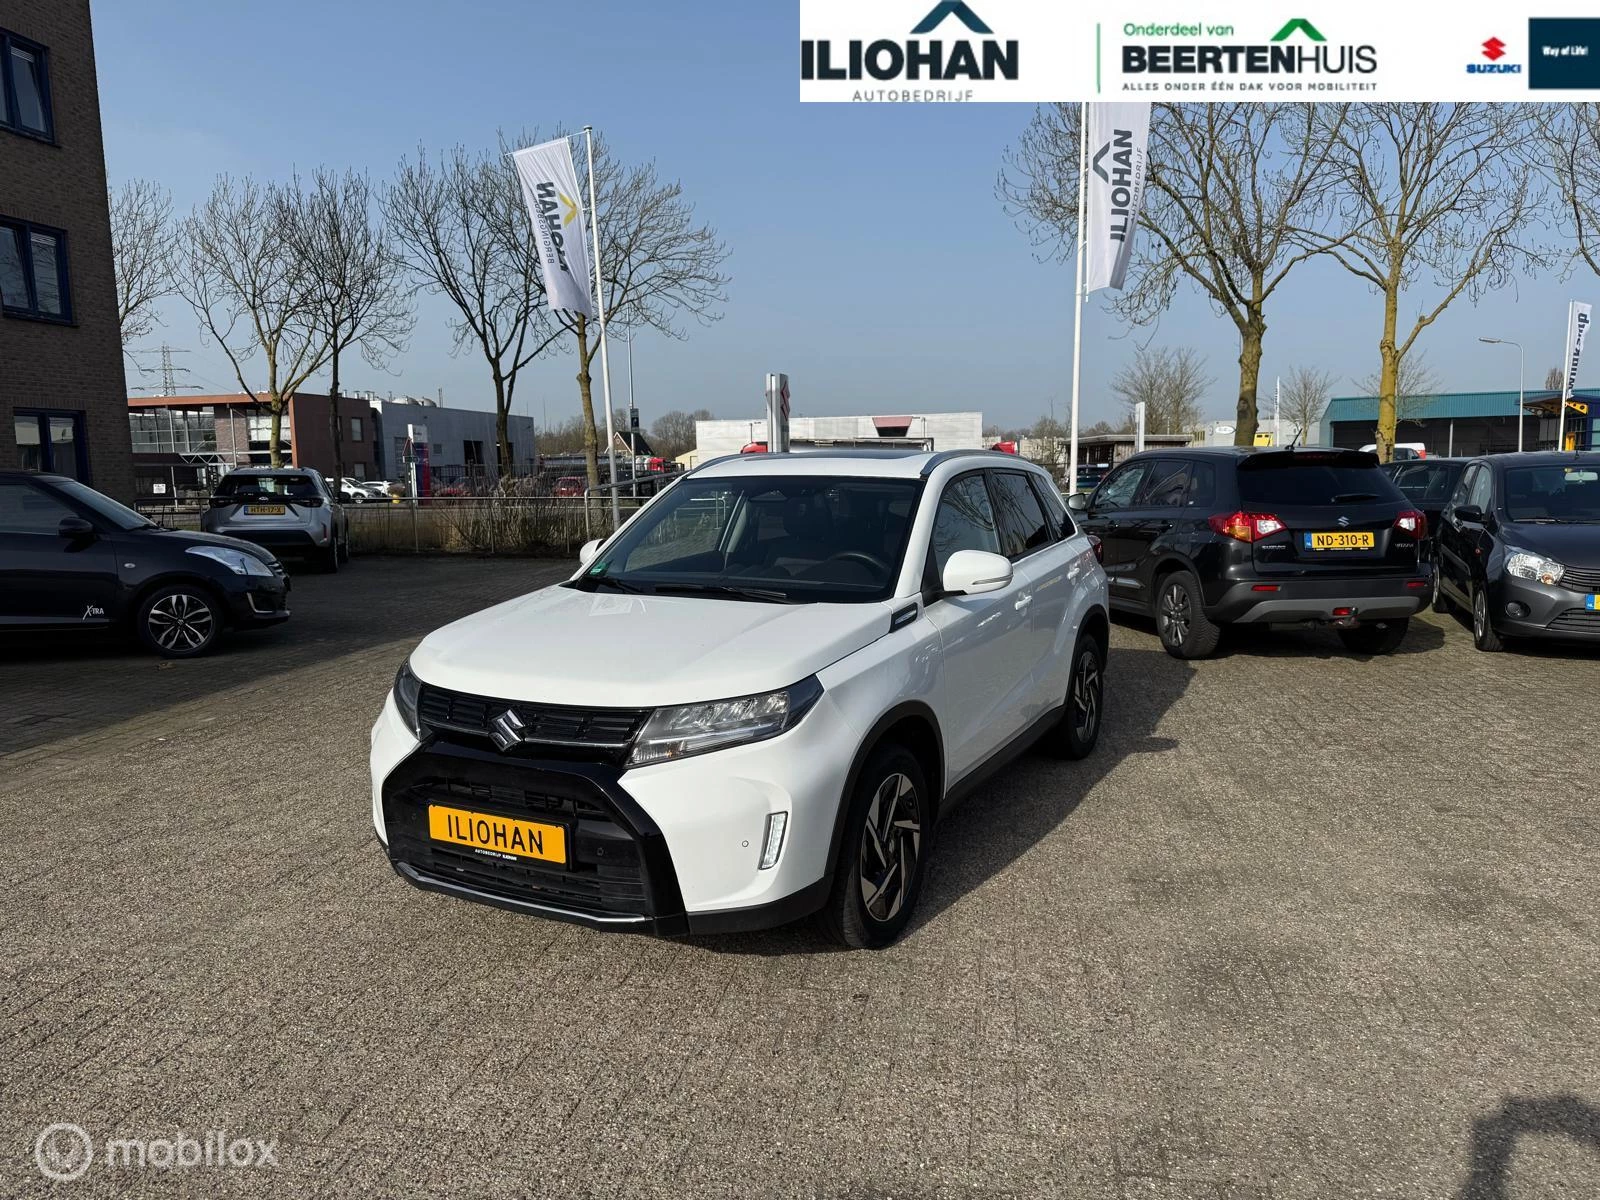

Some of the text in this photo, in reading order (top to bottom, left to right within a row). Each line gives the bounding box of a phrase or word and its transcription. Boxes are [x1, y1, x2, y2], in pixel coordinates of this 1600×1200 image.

[1110, 129, 1133, 242] ILIOHAN
[1317, 535, 1370, 546] ND-310-R
[447, 814, 544, 855] ILIOHAN
